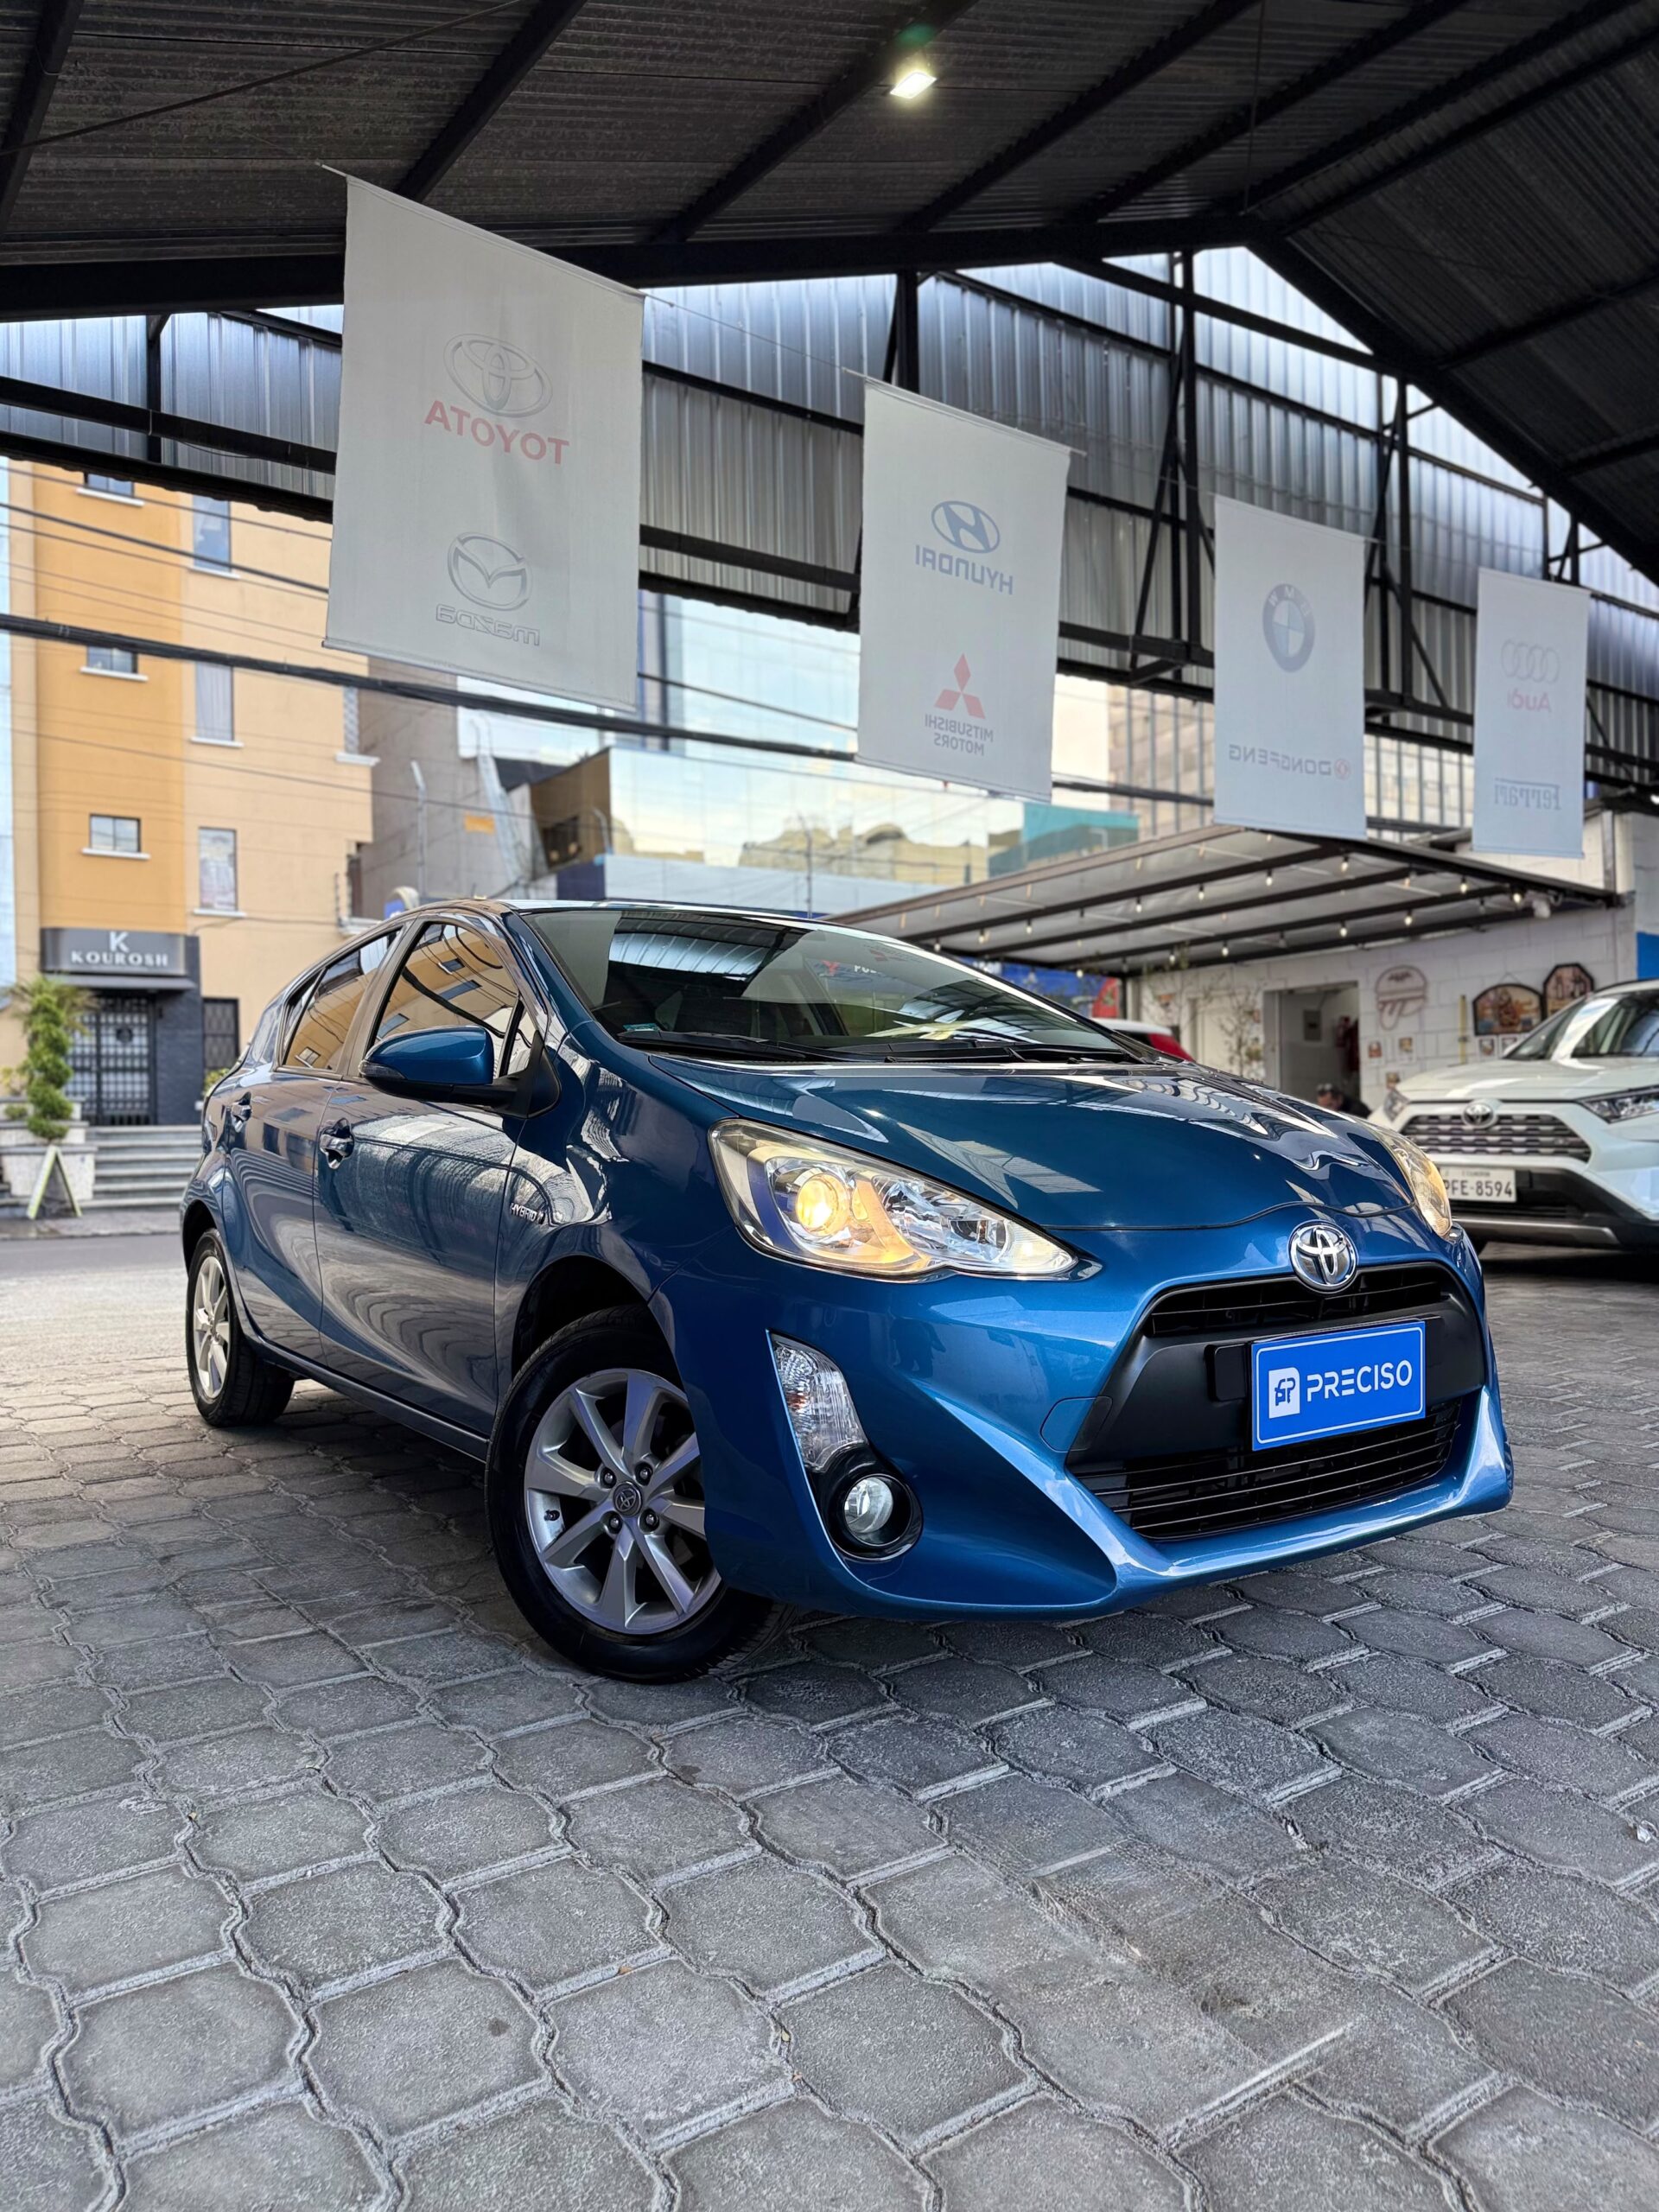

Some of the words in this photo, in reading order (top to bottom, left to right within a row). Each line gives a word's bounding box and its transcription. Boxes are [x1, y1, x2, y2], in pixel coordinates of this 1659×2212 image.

[109, 931, 130, 952] K
[71, 950, 169, 967] KOUROSH
[510, 1202, 538, 1222] HYBRID
[1306, 1359, 1413, 1402] PRECISO
